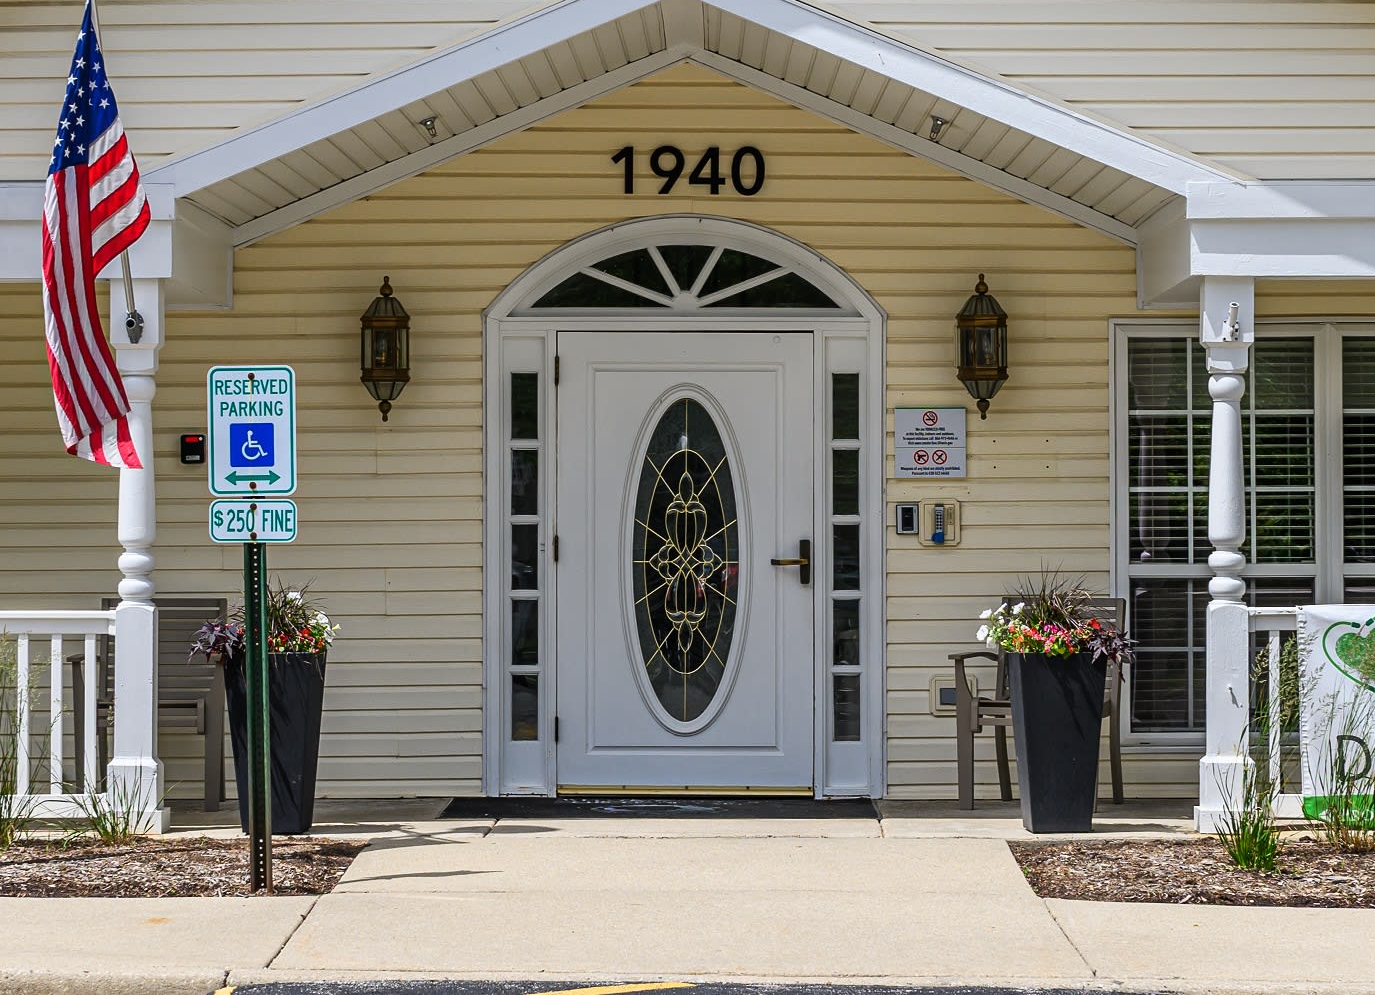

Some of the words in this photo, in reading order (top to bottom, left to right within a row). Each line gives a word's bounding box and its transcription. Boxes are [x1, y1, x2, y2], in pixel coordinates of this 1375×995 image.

[610, 145, 766, 196] 1940
[215, 379, 288, 395] RESERVED
[220, 400, 284, 417] PARKING
[262, 509, 293, 533] FINE
